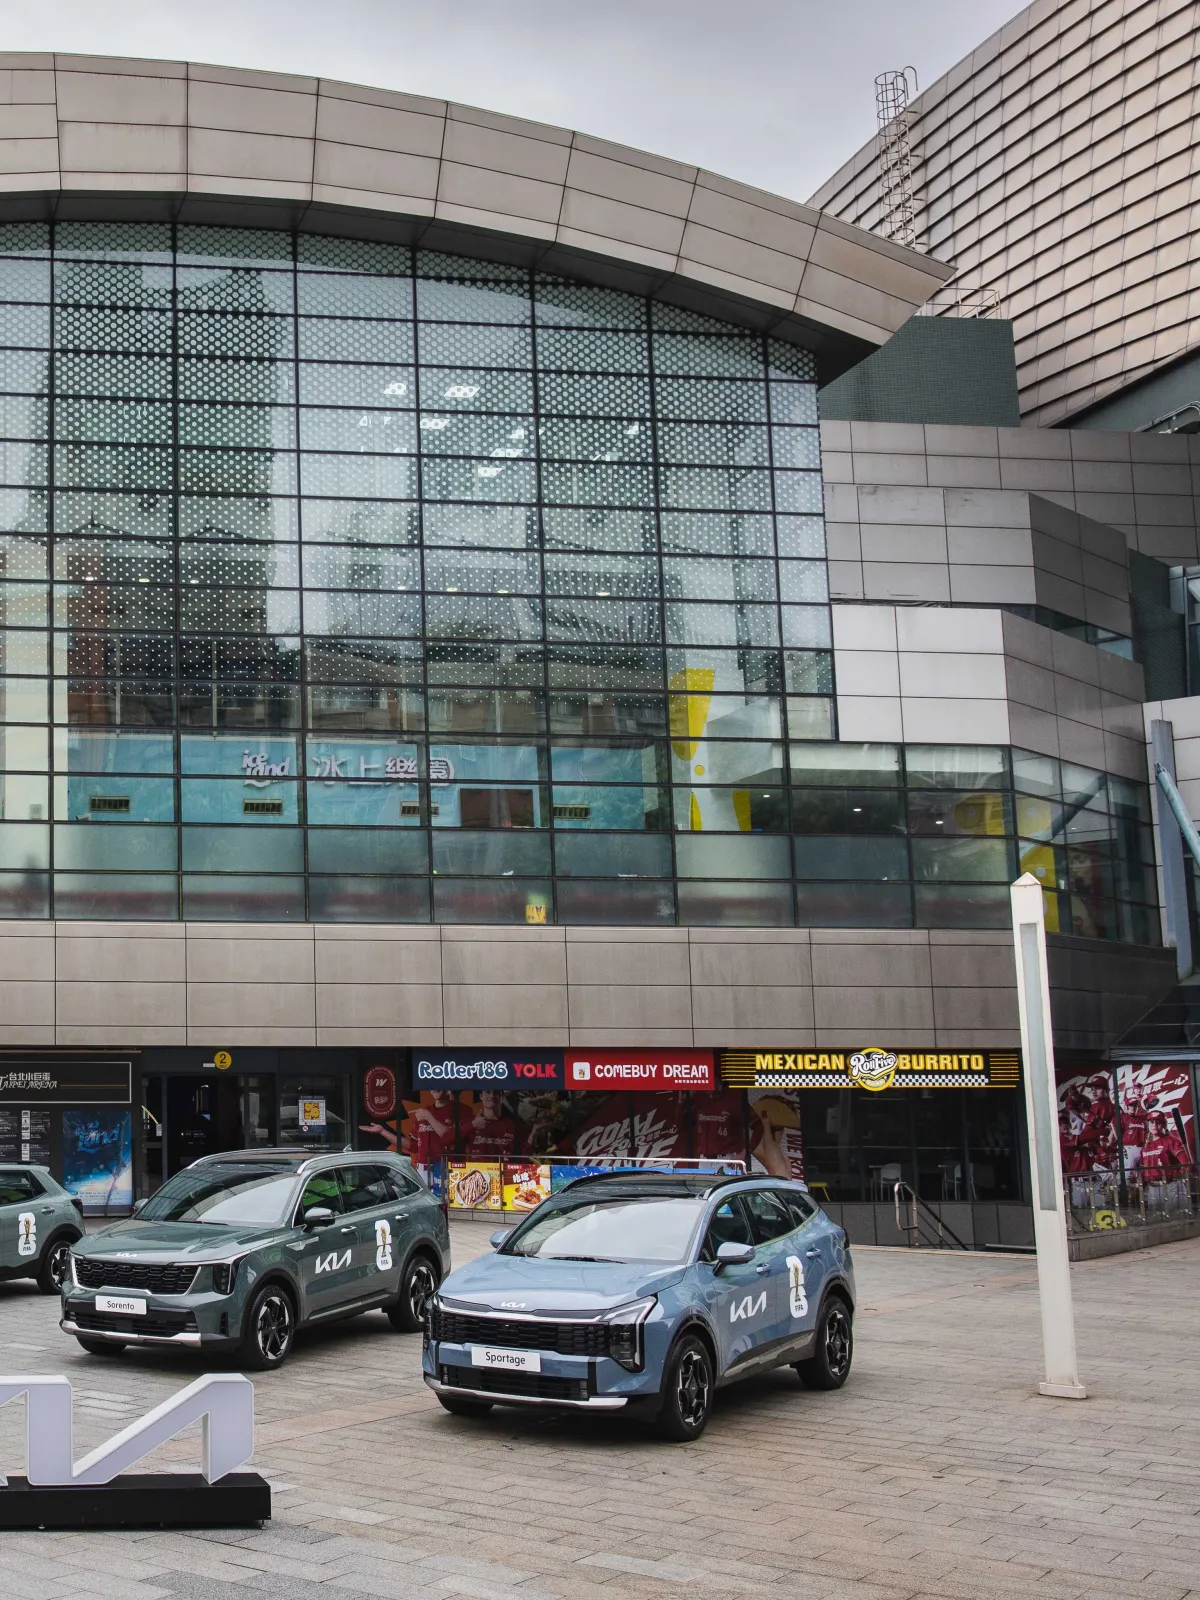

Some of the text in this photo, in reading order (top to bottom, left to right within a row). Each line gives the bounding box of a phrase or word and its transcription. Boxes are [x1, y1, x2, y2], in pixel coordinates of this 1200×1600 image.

[311, 755, 455, 787] 冰上樂園
[219, 1053, 227, 1064] 2
[755, 1053, 846, 1071] MEXICAN
[898, 1053, 984, 1071] BURRITO
[8, 1072, 51, 1081] 台北小巨蛋
[417, 1061, 559, 1079] Roller186 YOLK
[594, 1064, 709, 1078] COMEBUY DREAM
[315, 1249, 352, 1274] KIA
[106, 1300, 135, 1311] Sorento
[730, 1291, 767, 1323] KIA
[485, 1351, 526, 1367] Sportage
